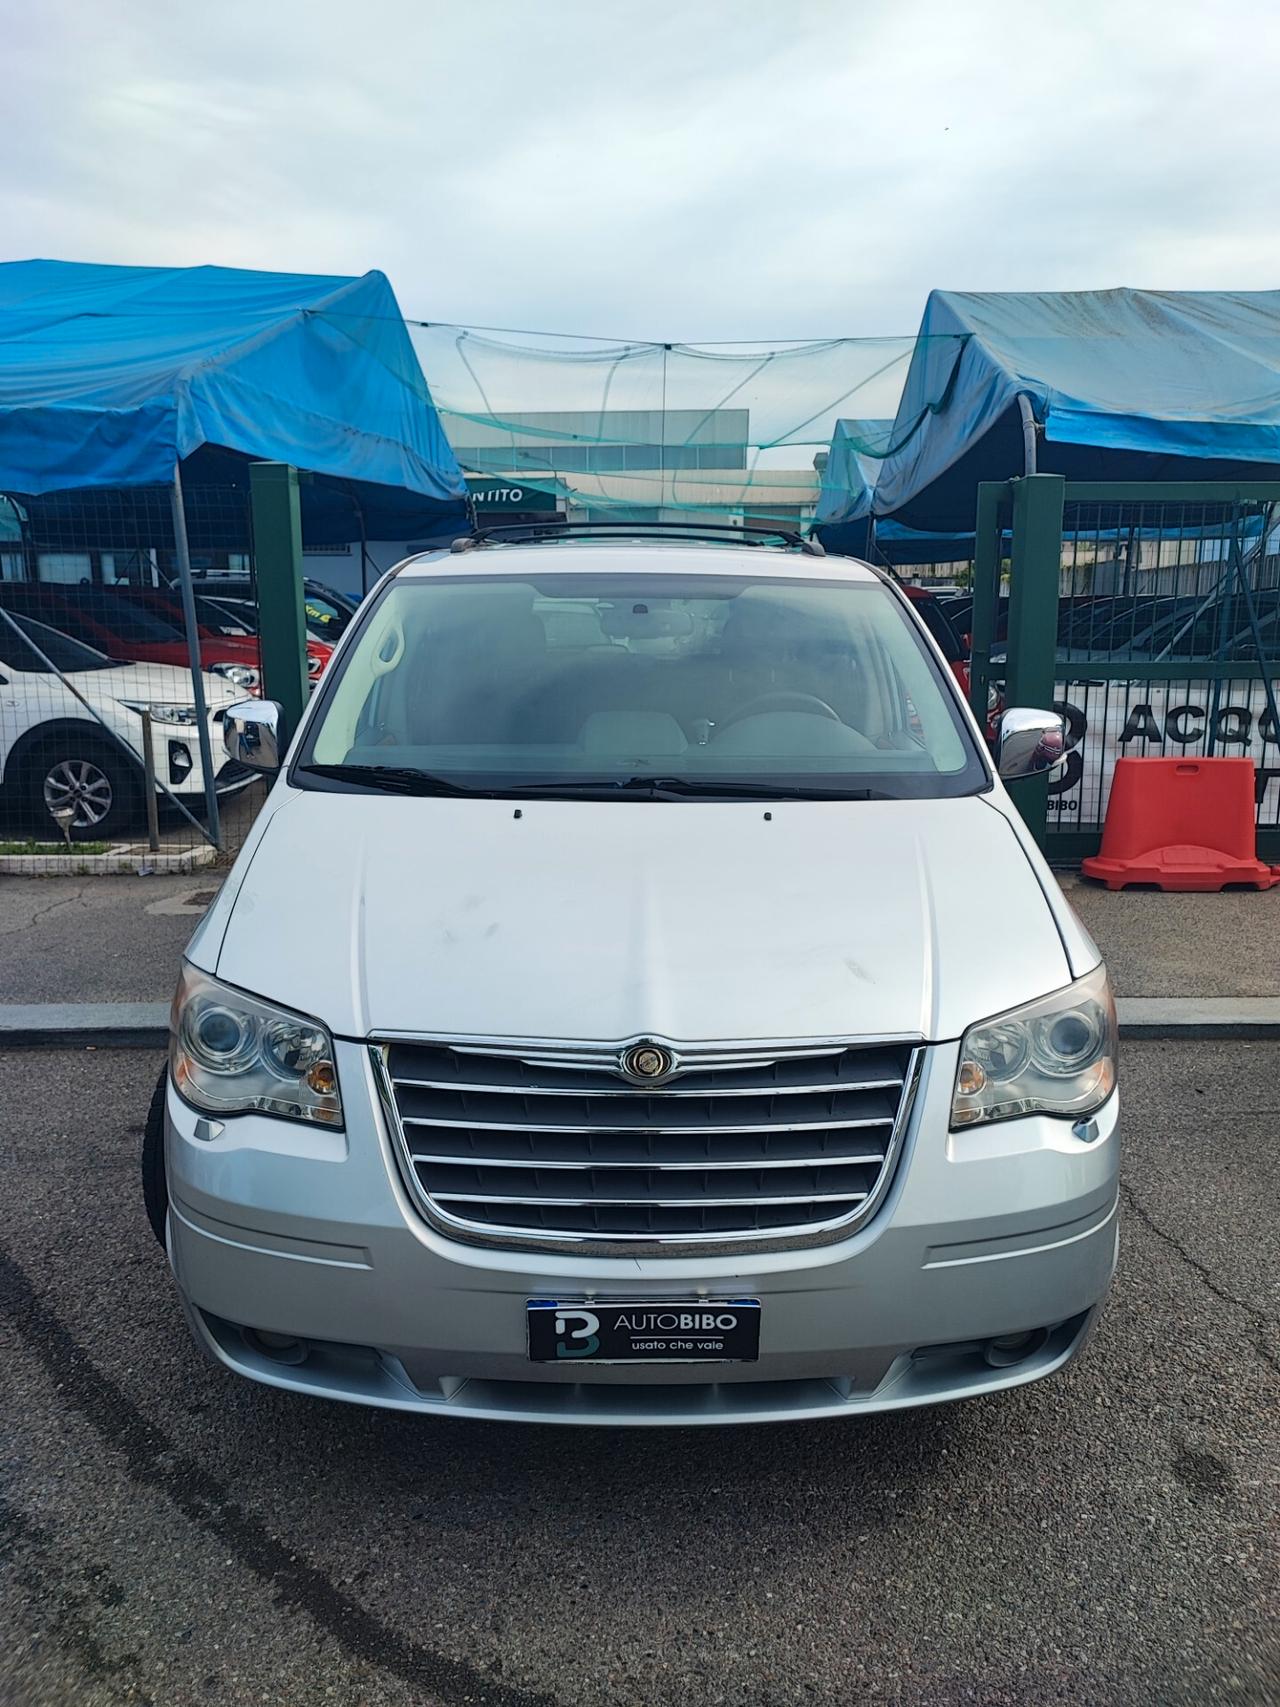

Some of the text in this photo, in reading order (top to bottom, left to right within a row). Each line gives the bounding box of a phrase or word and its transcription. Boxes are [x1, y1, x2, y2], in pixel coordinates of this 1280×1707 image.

[613, 1313, 738, 1330] AUTOBIBO
[632, 1340, 723, 1350] usato che vale
